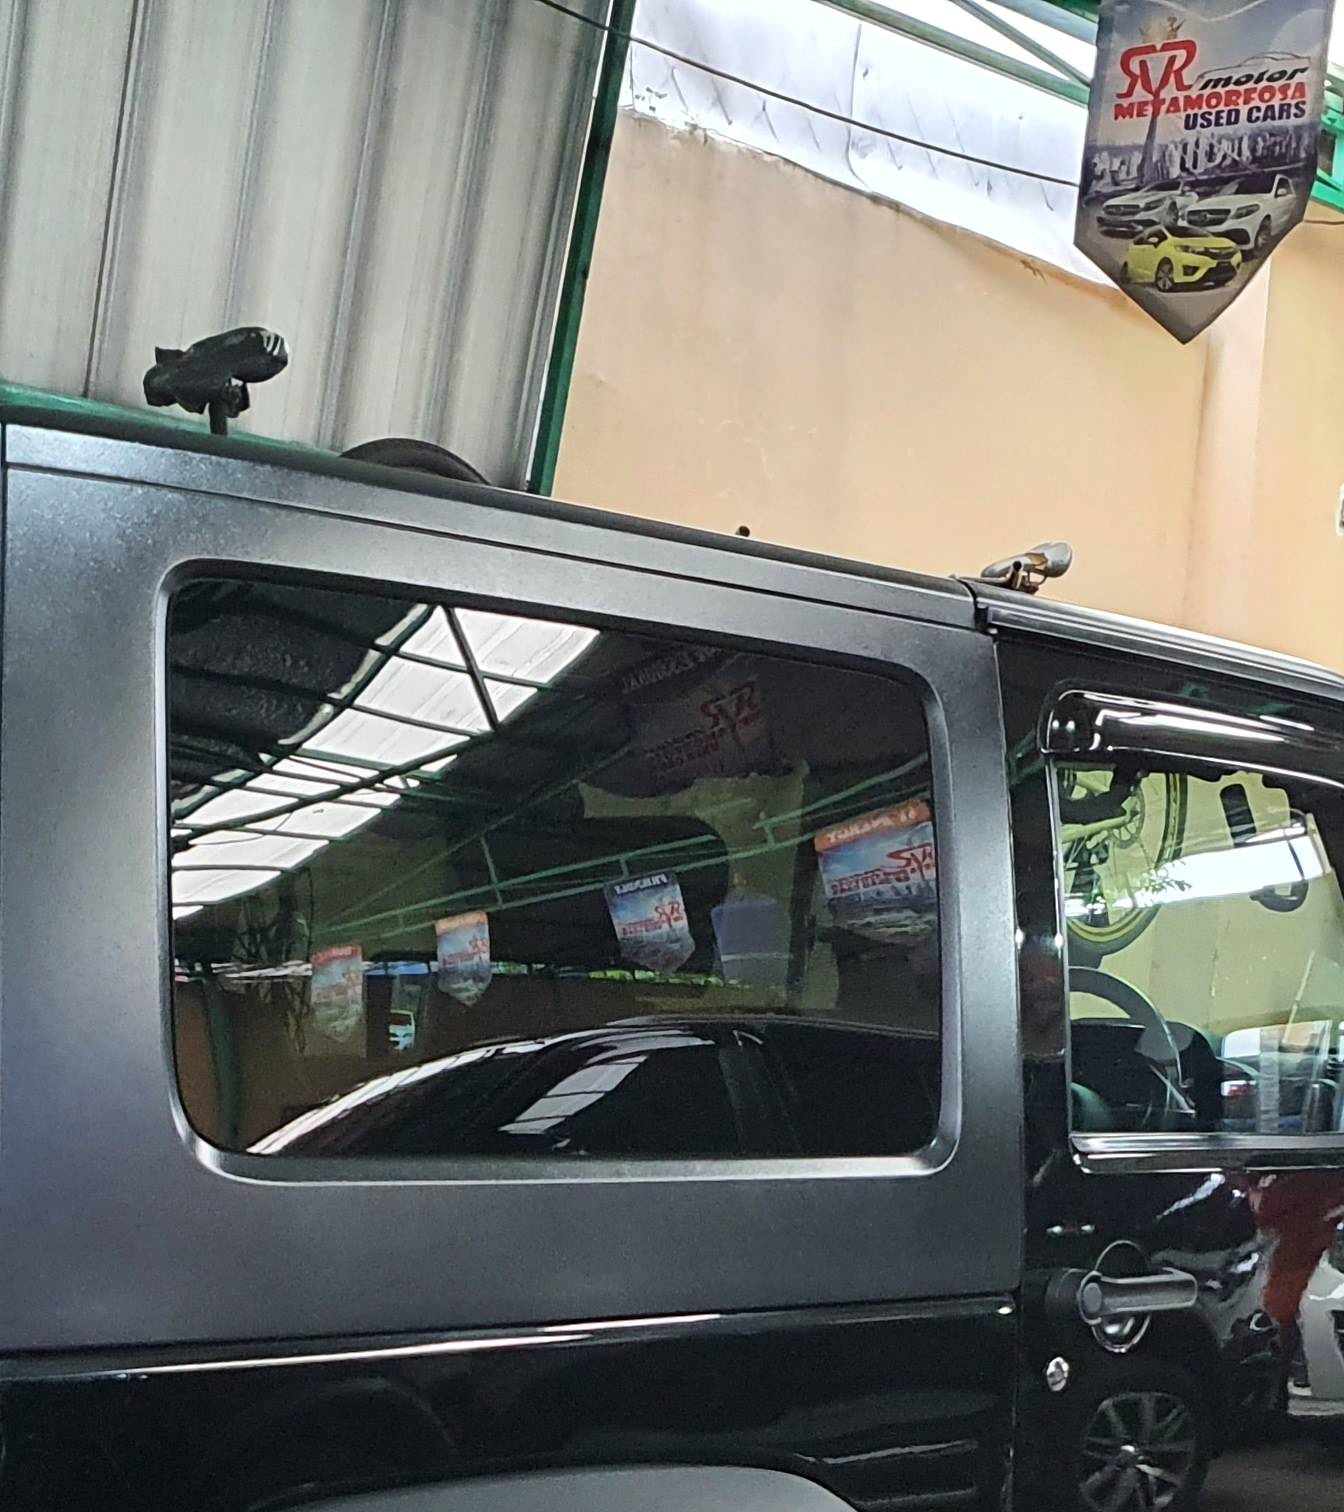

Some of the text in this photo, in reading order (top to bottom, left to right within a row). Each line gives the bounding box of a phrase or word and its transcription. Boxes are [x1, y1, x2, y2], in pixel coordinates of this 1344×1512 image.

[1114, 82, 1306, 120] METAMORFOSA
[1184, 101, 1306, 131] USED CARS
